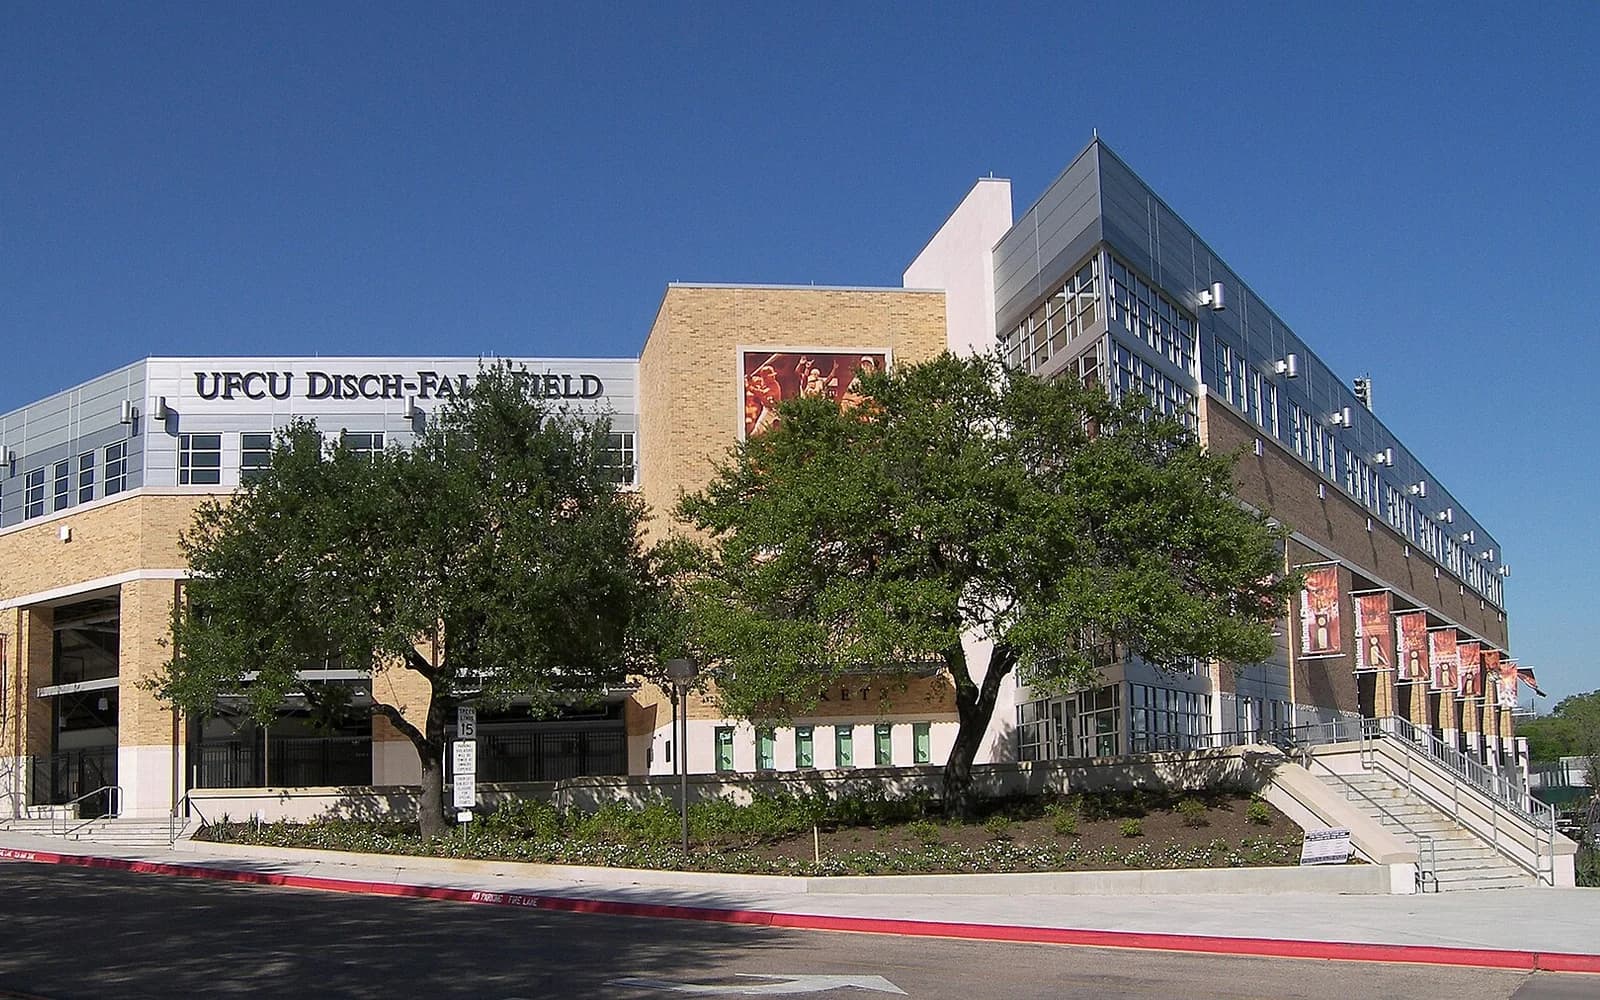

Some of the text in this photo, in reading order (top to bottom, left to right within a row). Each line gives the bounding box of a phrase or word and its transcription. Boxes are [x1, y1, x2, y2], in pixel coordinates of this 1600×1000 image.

[194, 372, 294, 400] UFCU
[305, 371, 489, 400] DISCH-FAL
[461, 722, 473, 735] 15
[471, 892, 480, 901] NO
